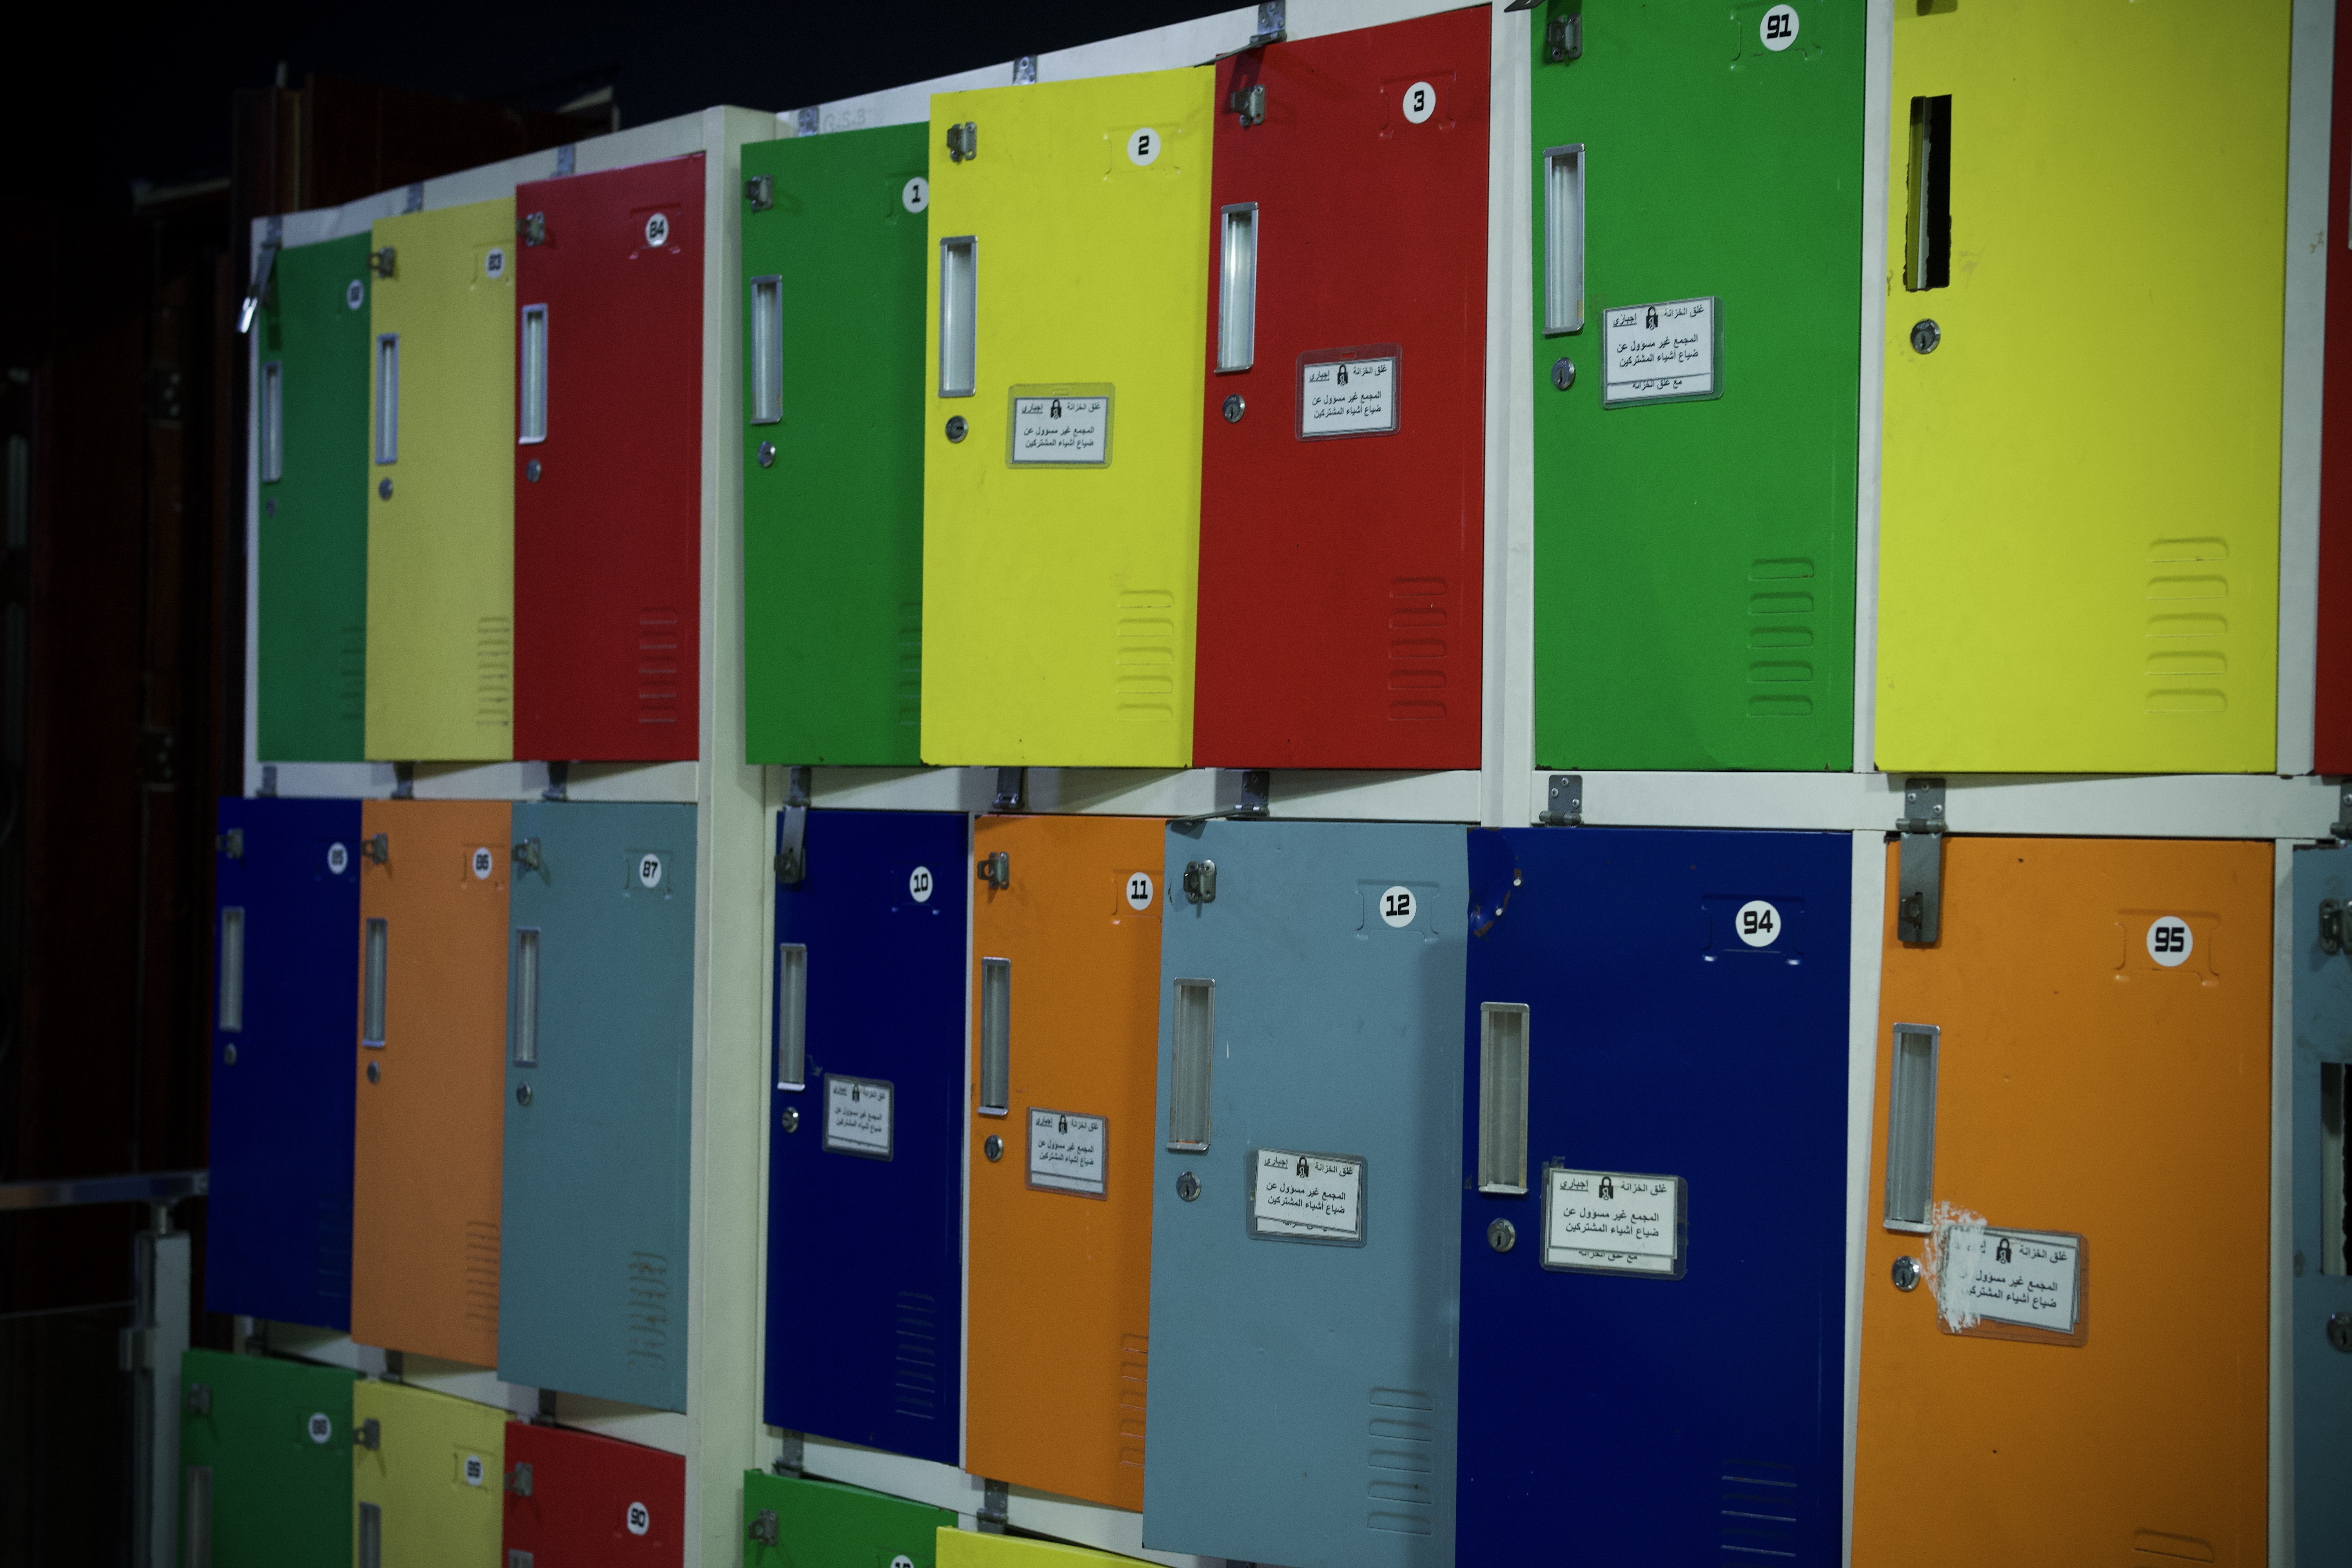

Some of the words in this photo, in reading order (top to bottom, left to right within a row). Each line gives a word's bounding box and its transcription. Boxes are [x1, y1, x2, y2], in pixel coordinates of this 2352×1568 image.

[1767, 13, 1791, 39] 91
[1414, 90, 1425, 112] 3
[1138, 135, 1149, 156] 2
[912, 185, 921, 203] 1
[649, 220, 665, 239] 84
[1664, 308, 1687, 318] الخزانة
[1690, 305, 1704, 317] غلق
[1659, 336, 1670, 349] غير
[1674, 334, 1698, 348] المجمع
[1617, 344, 1628, 352] عن
[1620, 354, 1654, 367] المشتركين
[1679, 349, 1698, 362] ضياع
[1353, 366, 1372, 376] الخزانة
[1375, 364, 1387, 375] غلق
[1312, 396, 1321, 405] عن
[1348, 392, 1357, 403] غير
[1361, 391, 1381, 403] المجمع
[1314, 407, 1344, 418] المشتركين
[1364, 405, 1381, 416] ضياع
[642, 860, 658, 878] 87
[914, 873, 928, 893] 10
[1131, 880, 1148, 900] 11
[1386, 894, 1410, 916] 12
[1744, 909, 1773, 935] 94
[2155, 927, 2185, 953] 95
[1315, 1162, 1337, 1174] الخزانة
[1339, 1167, 1353, 1176] غلق
[1267, 1182, 1277, 1190] عن
[1280, 1183, 1304, 1194] مسؤول
[1621, 1181, 1647, 1193] الخزانة
[1650, 1184, 1666, 1195] غلق
[1308, 1187, 1319, 1197] غير
[1322, 1192, 1345, 1201] المجمع
[1268, 1196, 1302, 1207] المشتركين
[1326, 1204, 1345, 1214] ضياع
[1564, 1208, 1576, 1217] عن
[1580, 1208, 1609, 1219] مسؤول
[1613, 1210, 1626, 1221] غير
[1630, 1213, 1659, 1223] المجمع
[1566, 1222, 1607, 1233] المشتركين
[1636, 1228, 1659, 1239] ضياع
[2020, 1245, 2047, 1259] الخزانة
[2050, 1251, 2067, 1263] غلق
[2009, 1276, 2023, 1287] غير
[2028, 1282, 2058, 1292] المجمع
[1969, 1286, 2002, 1298] المشترك
[2032, 1299, 2056, 1308] ضياع
[630, 1508, 646, 1528] 90
